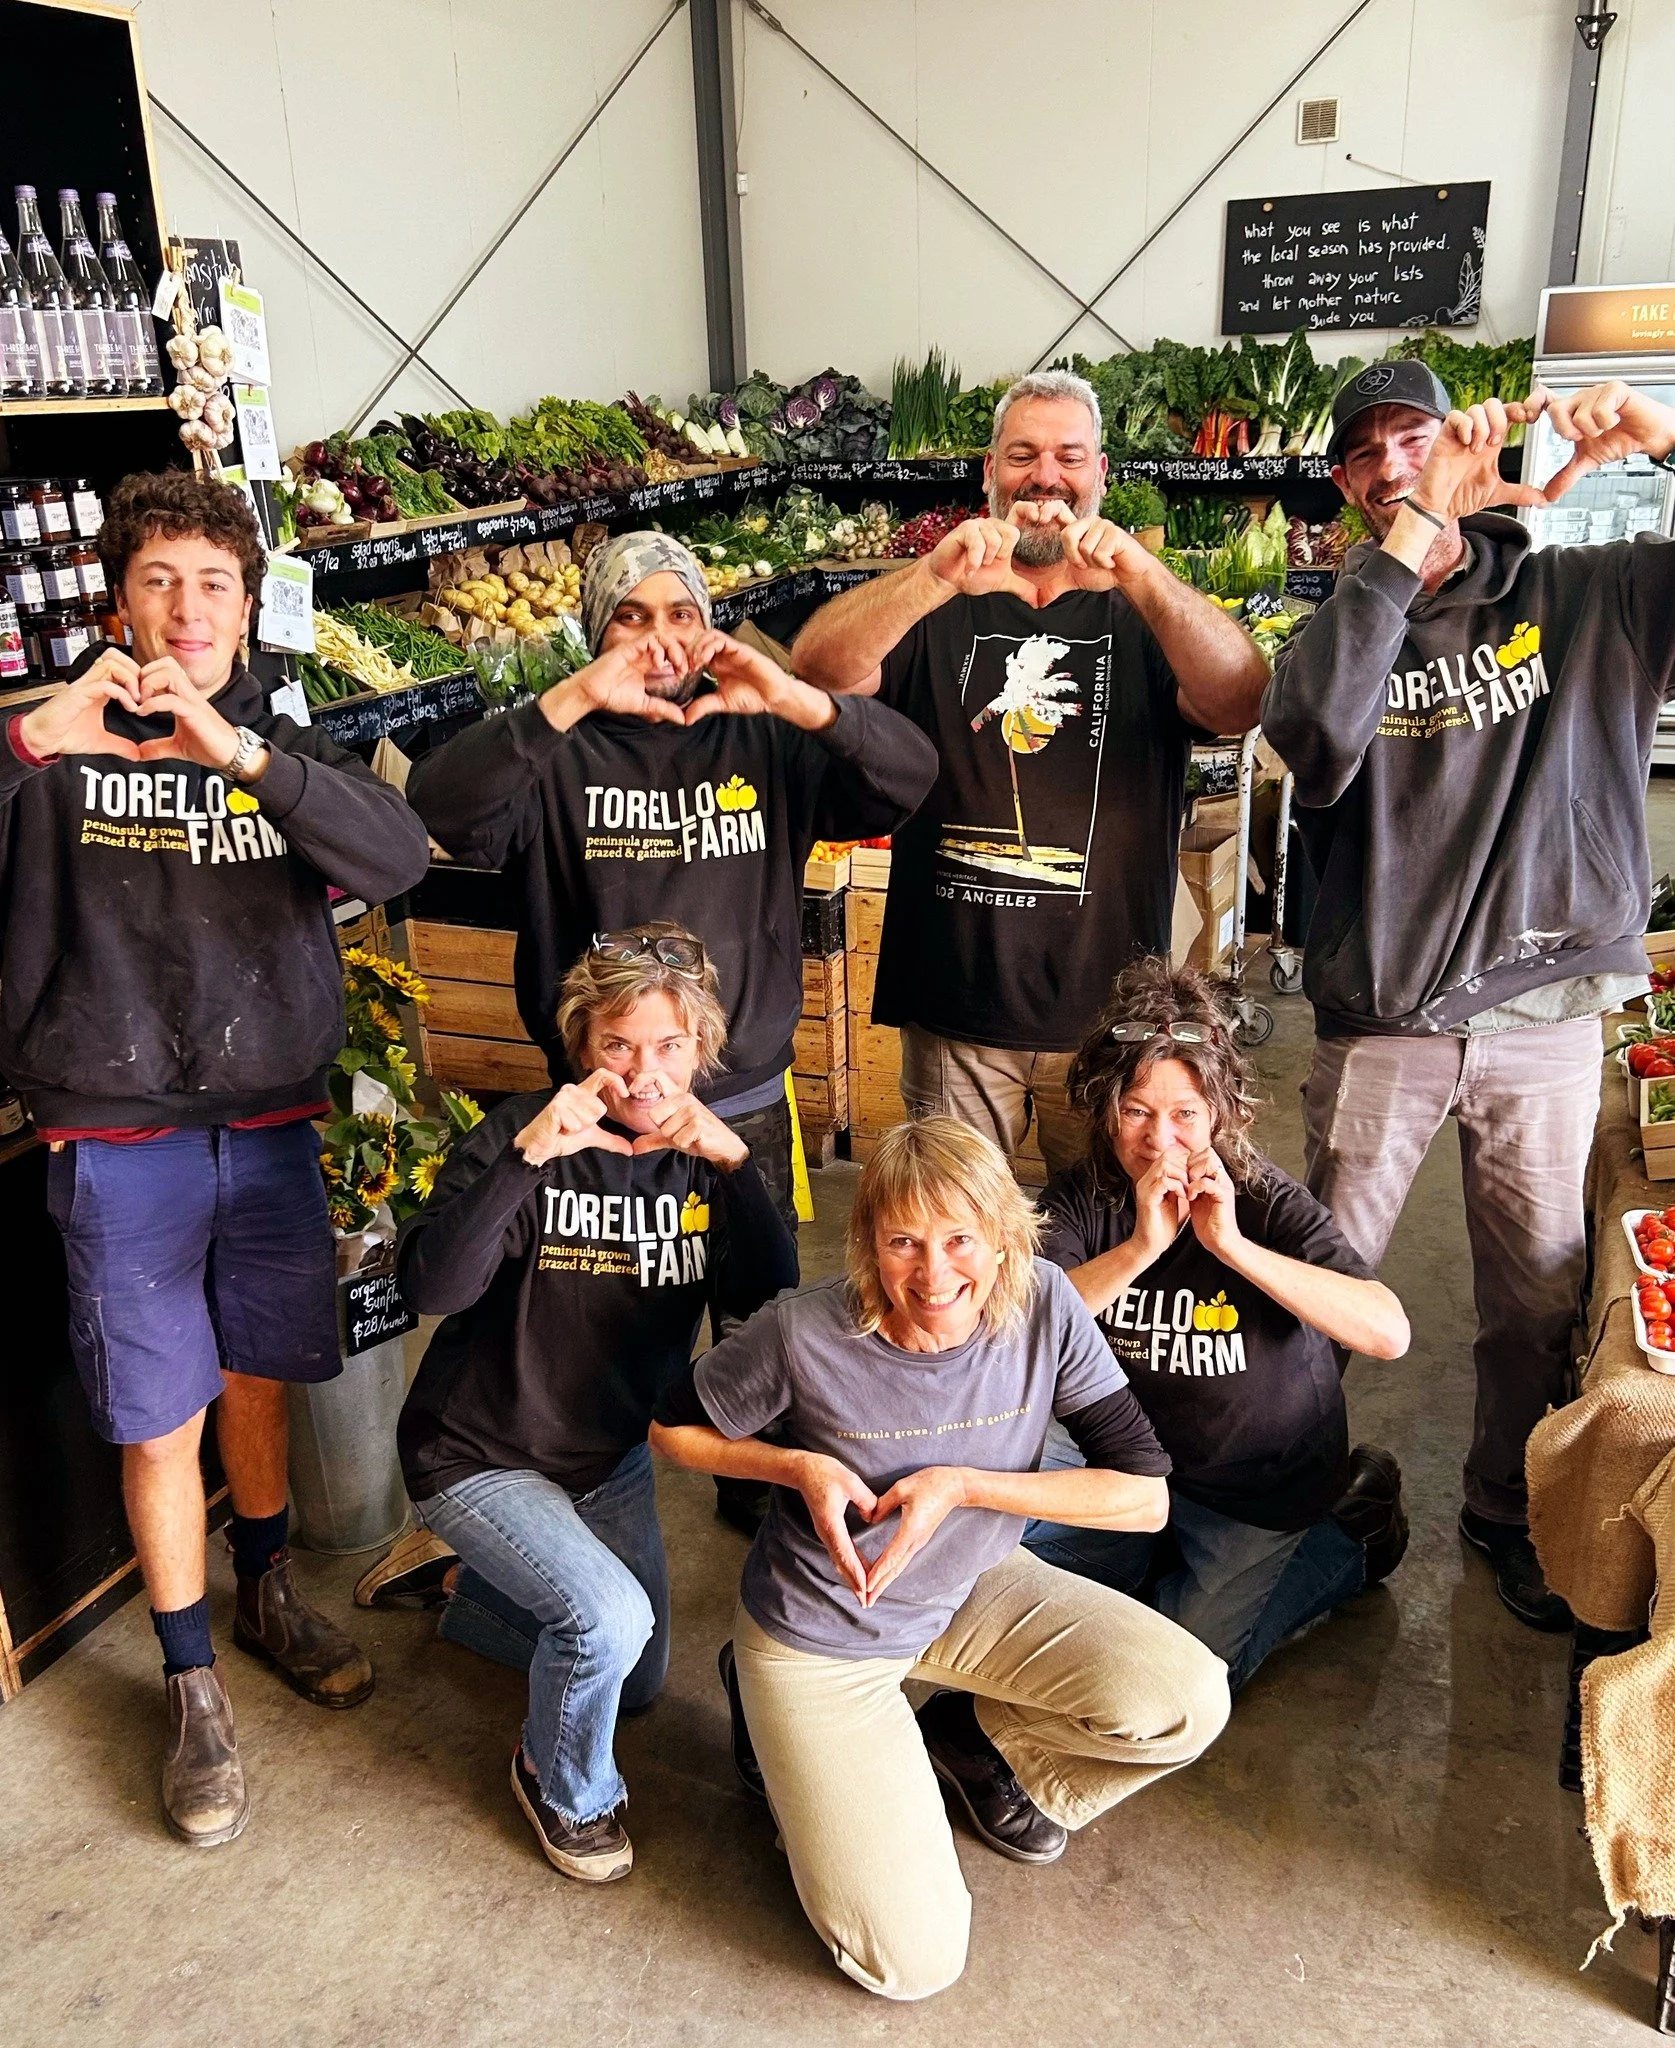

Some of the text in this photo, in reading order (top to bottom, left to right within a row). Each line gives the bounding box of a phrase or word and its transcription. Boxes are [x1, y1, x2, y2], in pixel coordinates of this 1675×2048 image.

[1244, 211, 1419, 243] what you see is what
[1242, 233, 1450, 266] the local season has provided.
[1262, 264, 1424, 291] throw away your lists
[1238, 300, 1260, 312] and
[1272, 296, 1291, 311] let
[1355, 287, 1402, 305] nature
[1308, 311, 1340, 330] guide
[1631, 303, 1669, 322] TAKE
[1133, 461, 1158, 475] curly
[1160, 460, 1228, 472] rainbow chard
[1299, 456, 1329, 472] leeks
[421, 529, 438, 547] baby
[351, 541, 371, 559] salad
[1388, 643, 1501, 711] ORELLO
[1088, 655, 1108, 748] CALIFORNIA
[1465, 653, 1550, 732] FARM
[1381, 705, 1458, 727] ninsula grown
[1411, 726, 1421, 737] &
[1424, 713, 1470, 738] gathered
[584, 781, 716, 830] TORELLO
[80, 830, 126, 848] grazed
[128, 837, 141, 849] &
[82, 818, 186, 840] peninsula grown
[187, 814, 287, 865] FARM
[682, 810, 766, 863] FARM
[584, 845, 683, 861] grazed & gathered
[586, 835, 674, 849] peninsula grown
[962, 890, 1037, 908] ANGELES
[544, 1186, 679, 1242] TORELLO
[540, 1244, 631, 1263] peninsula grown
[538, 1257, 640, 1275] grazed & gathered
[350, 1273, 397, 1306] organic
[1108, 1335, 1141, 1348] grown
[1111, 1346, 1150, 1360] thered
[1151, 1331, 1247, 1377] FARM
[836, 1403, 1032, 1440] peninsula grown, grazed & gathered
